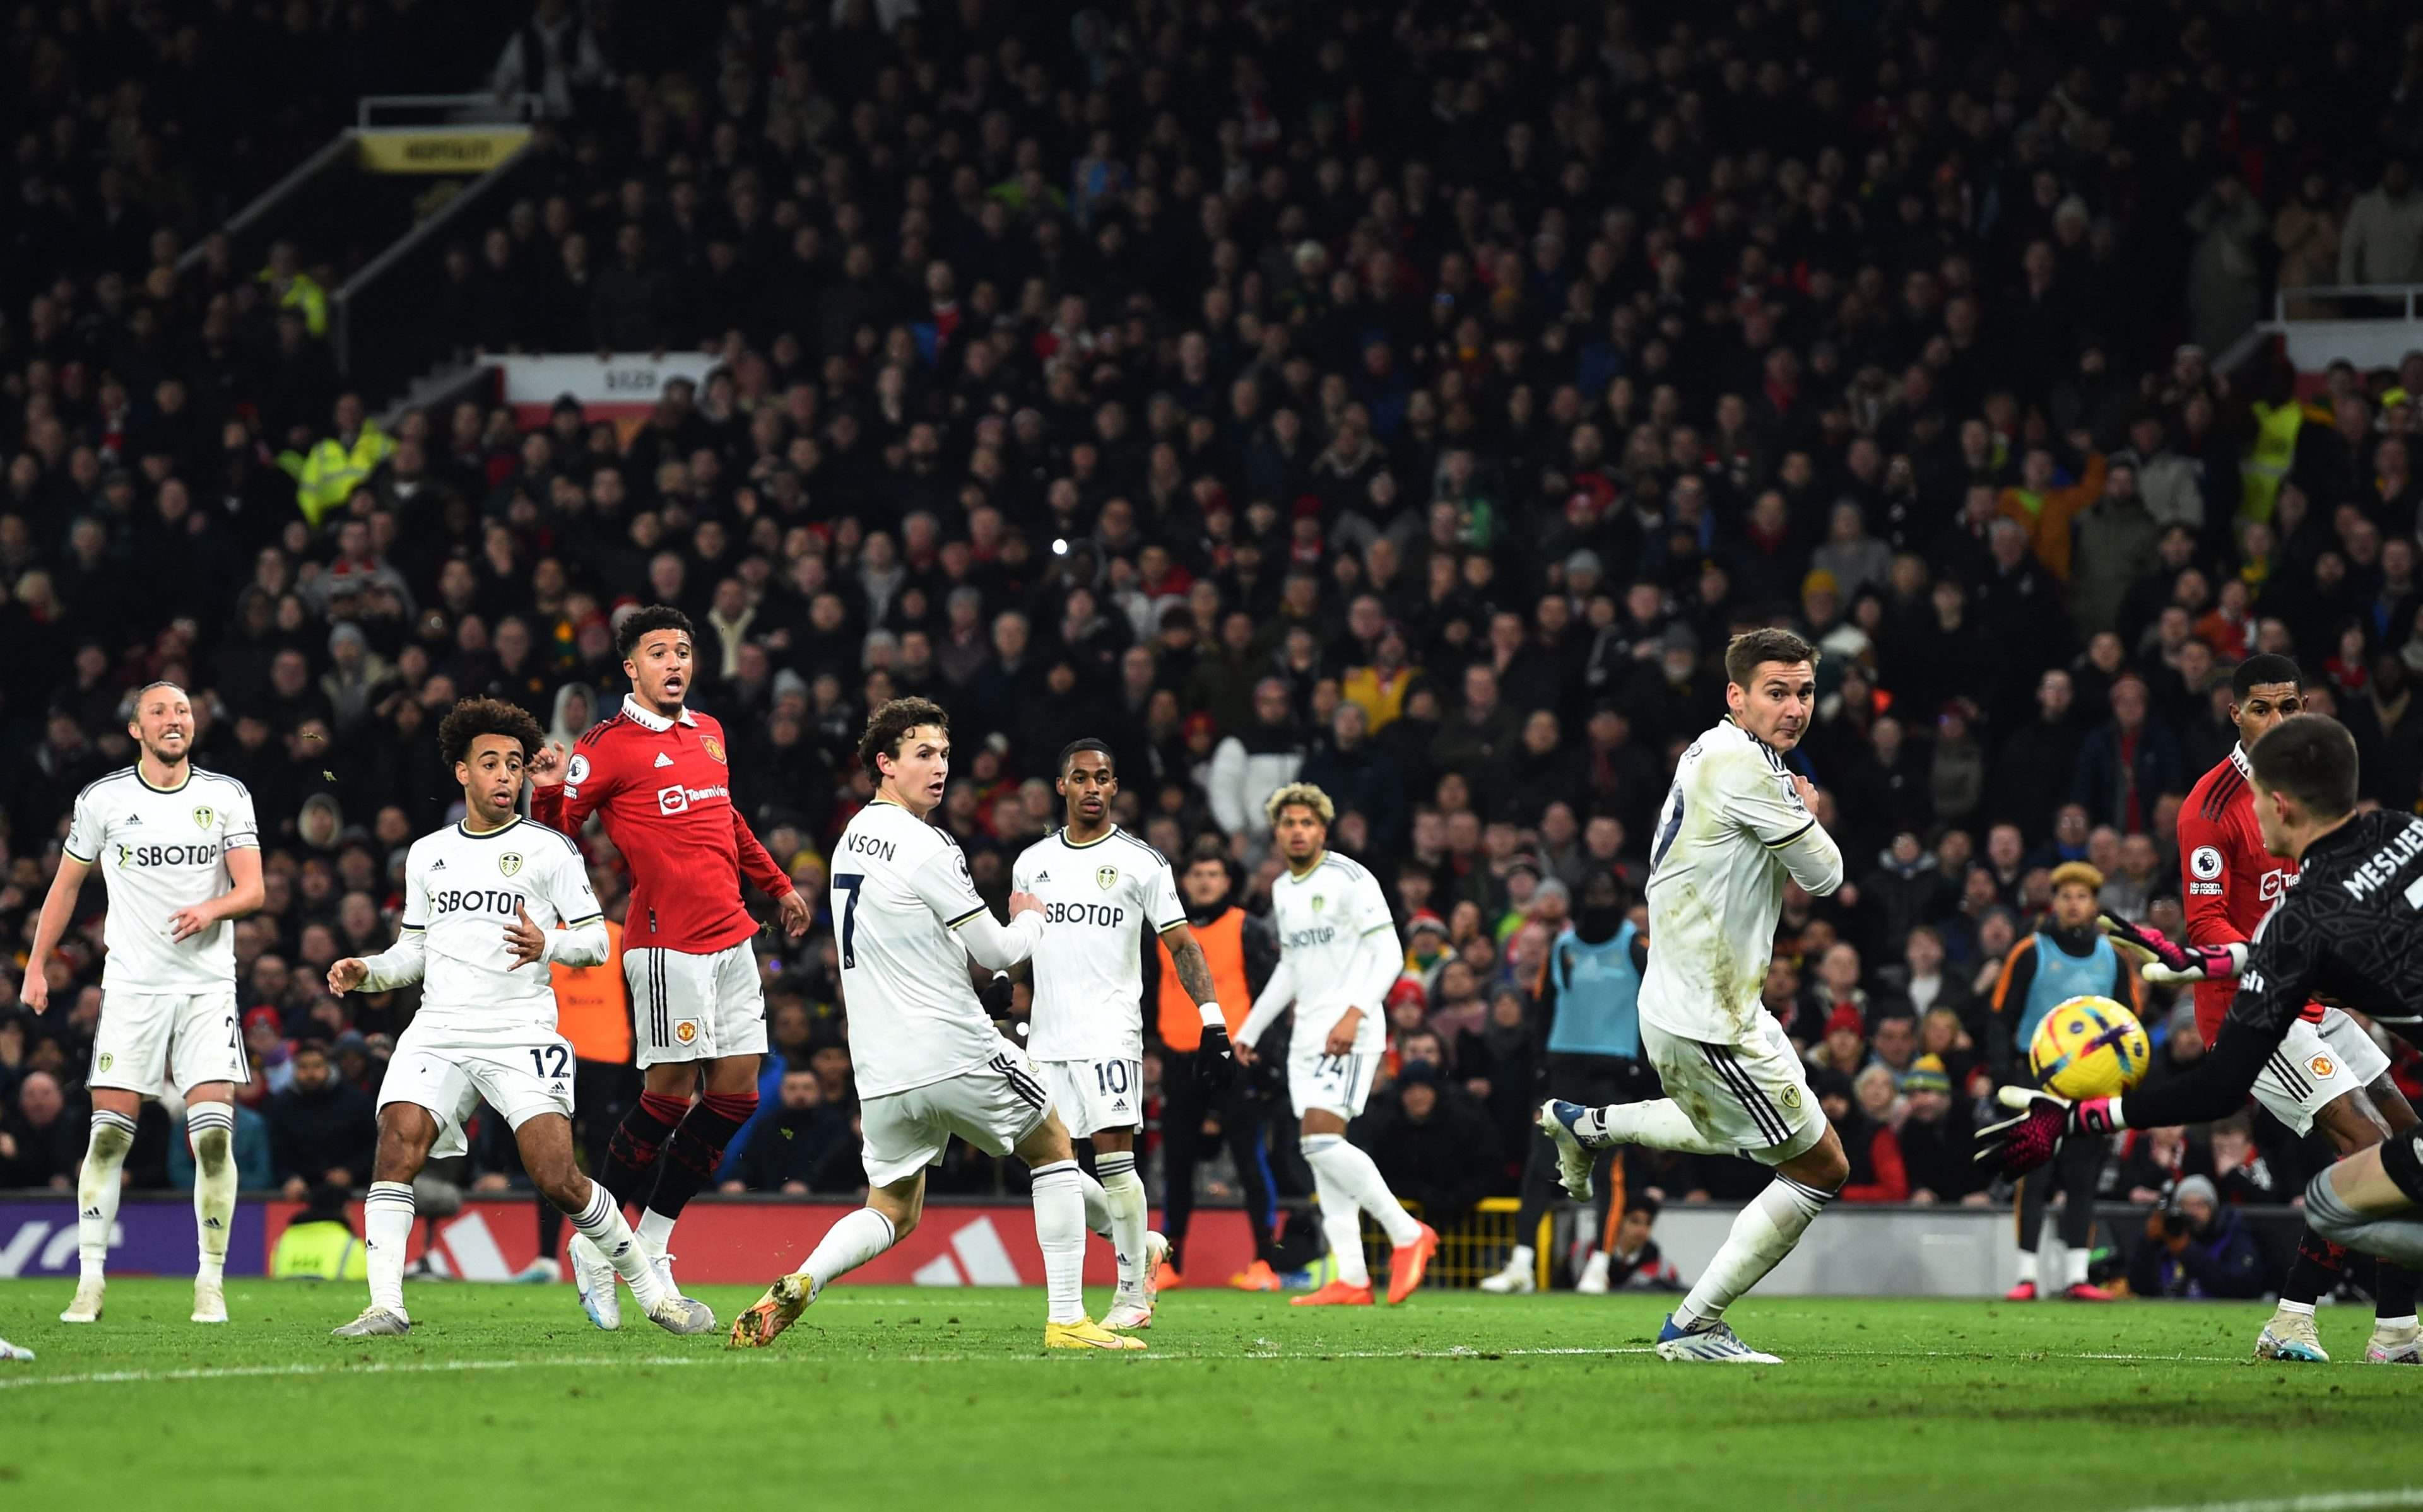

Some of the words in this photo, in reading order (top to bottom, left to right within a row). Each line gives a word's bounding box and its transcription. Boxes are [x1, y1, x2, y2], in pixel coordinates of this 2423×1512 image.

[137, 845, 216, 867] SBOTOP
[833, 873, 865, 970] 7
[1046, 903, 1124, 928] SBOTOP
[225, 1016, 237, 1049] 2
[530, 1044, 571, 1079] 12
[1095, 1059, 1128, 1097] 10
